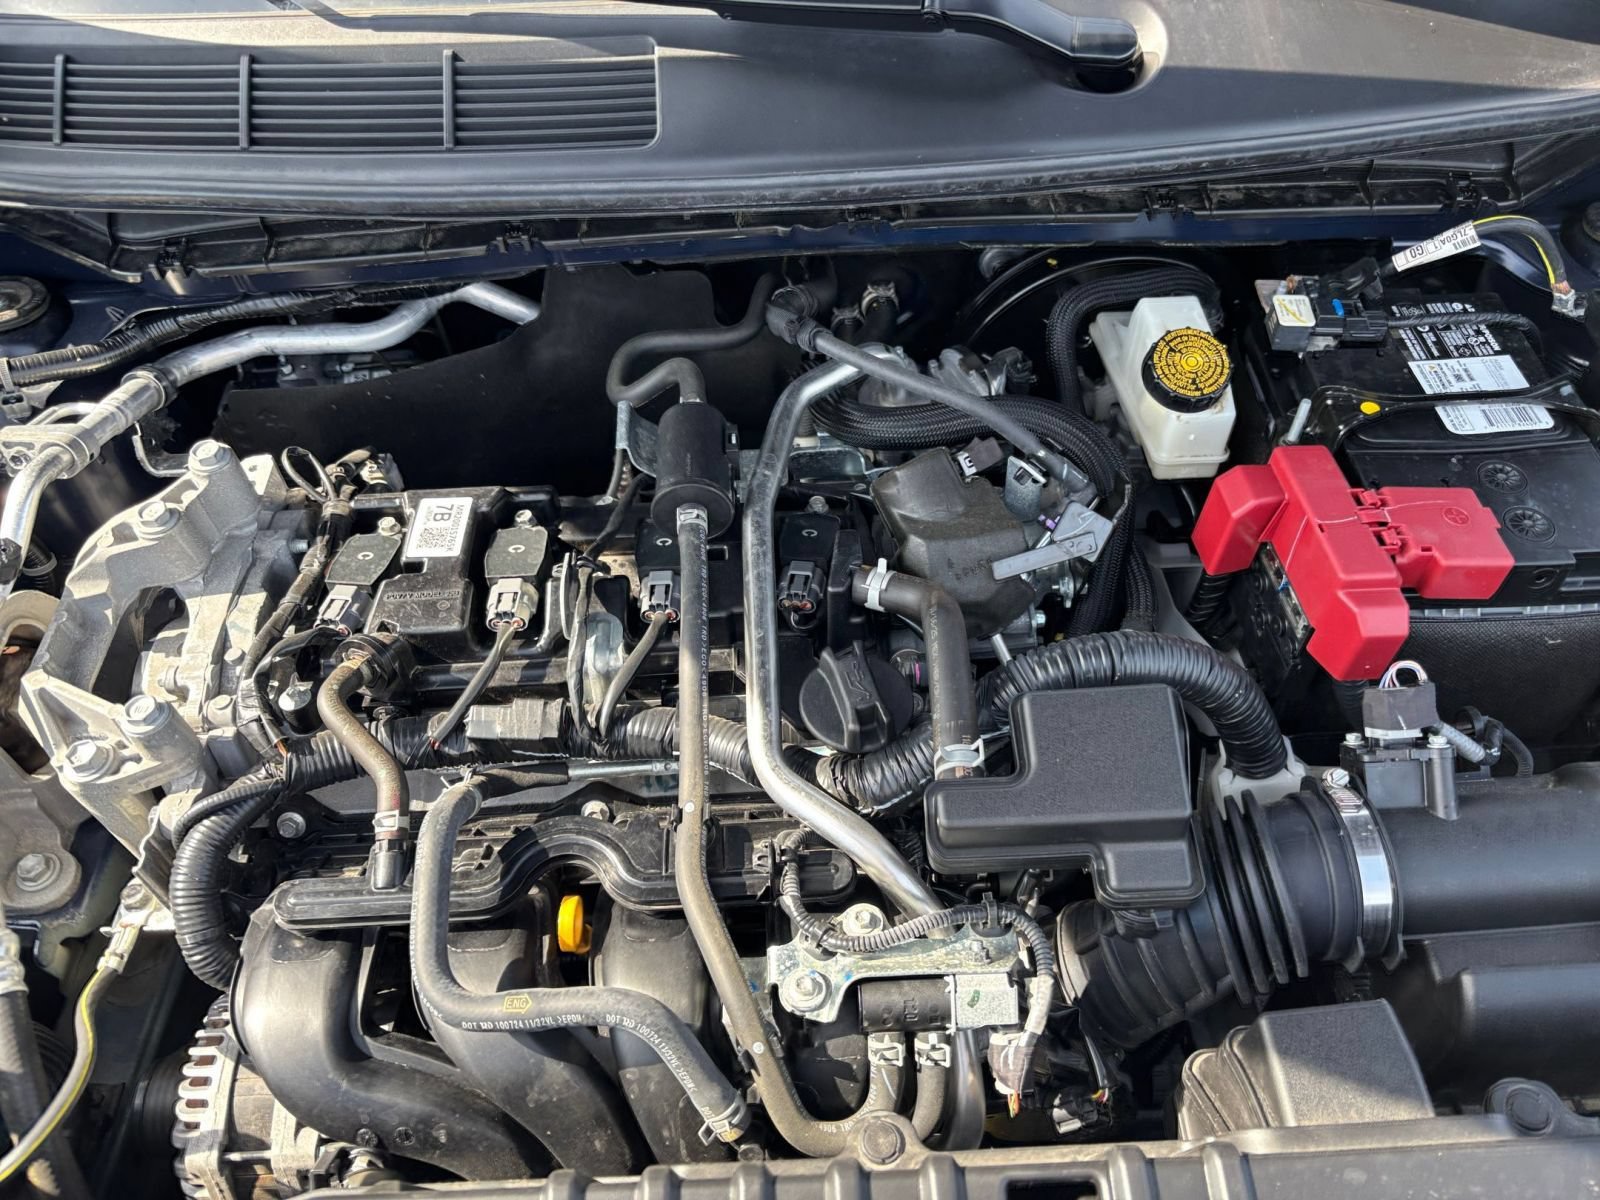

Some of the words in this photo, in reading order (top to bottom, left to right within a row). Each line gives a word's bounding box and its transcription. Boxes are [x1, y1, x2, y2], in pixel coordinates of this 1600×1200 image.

[433, 504, 454, 522] 7B
[506, 999, 527, 1009] ENG
[462, 1021, 477, 1030] DOT
[495, 1020, 524, 1030] 100724
[605, 1013, 621, 1024] DOT
[636, 1023, 660, 1045] 100724
